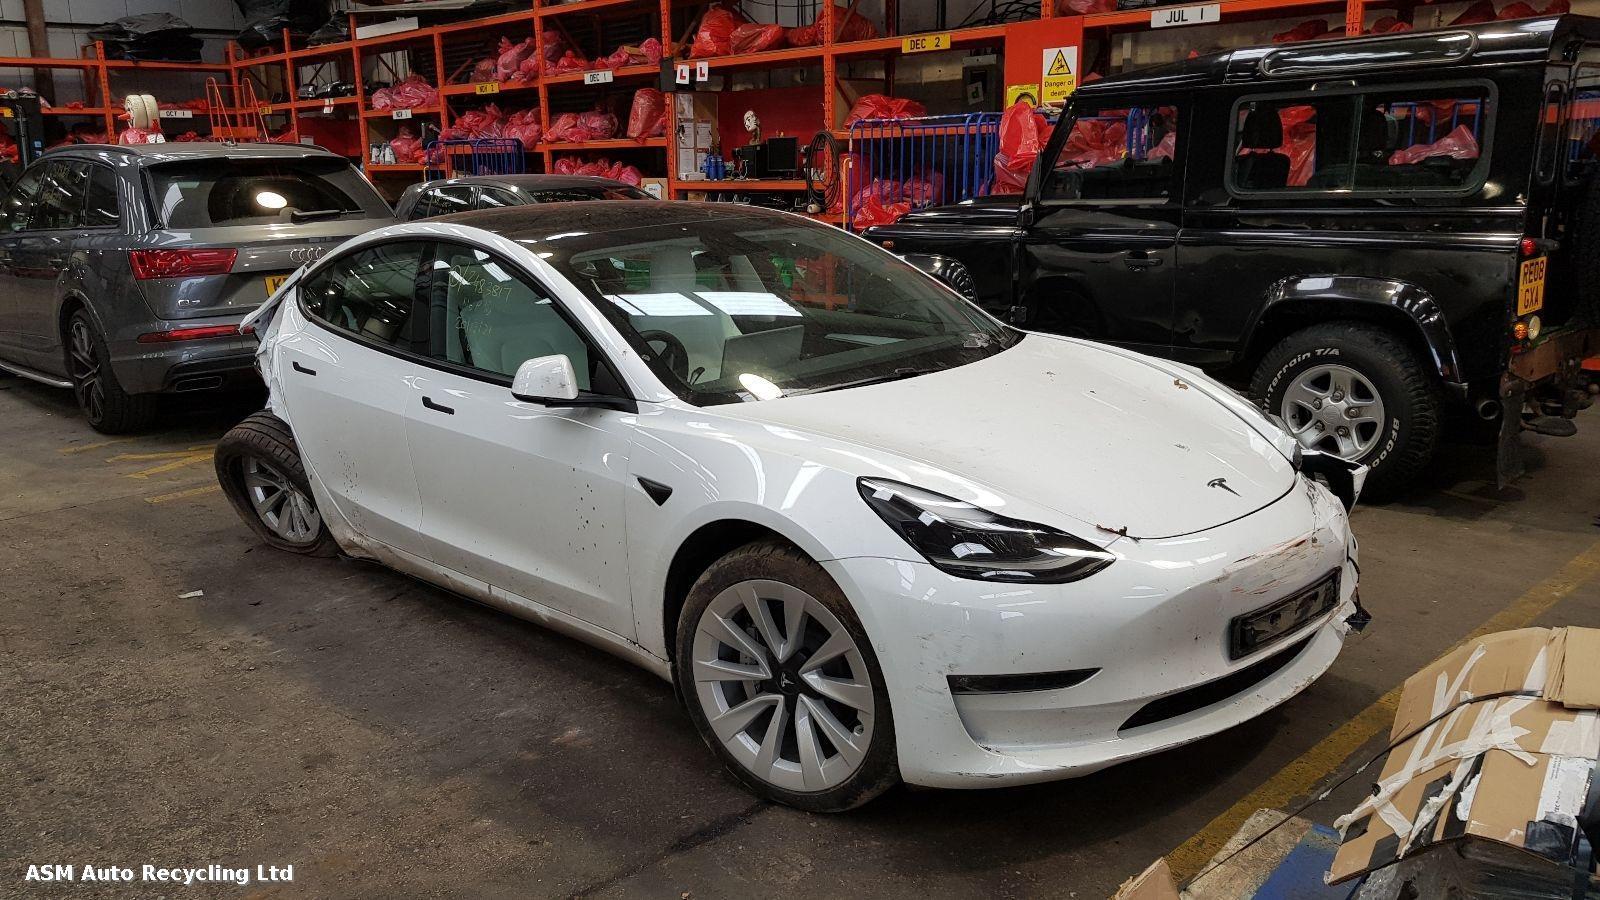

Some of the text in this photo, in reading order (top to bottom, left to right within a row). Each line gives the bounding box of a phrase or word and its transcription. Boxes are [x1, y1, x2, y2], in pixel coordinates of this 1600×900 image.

[1165, 9, 1188, 23] JUL
[910, 36, 941, 50] DEC 2
[589, 73, 600, 82] DEC
[679, 69, 687, 80] L
[699, 66, 706, 77] L
[1522, 260, 1545, 285] RE08
[1523, 285, 1539, 309] GXA
[1314, 347, 1340, 356] T/A
